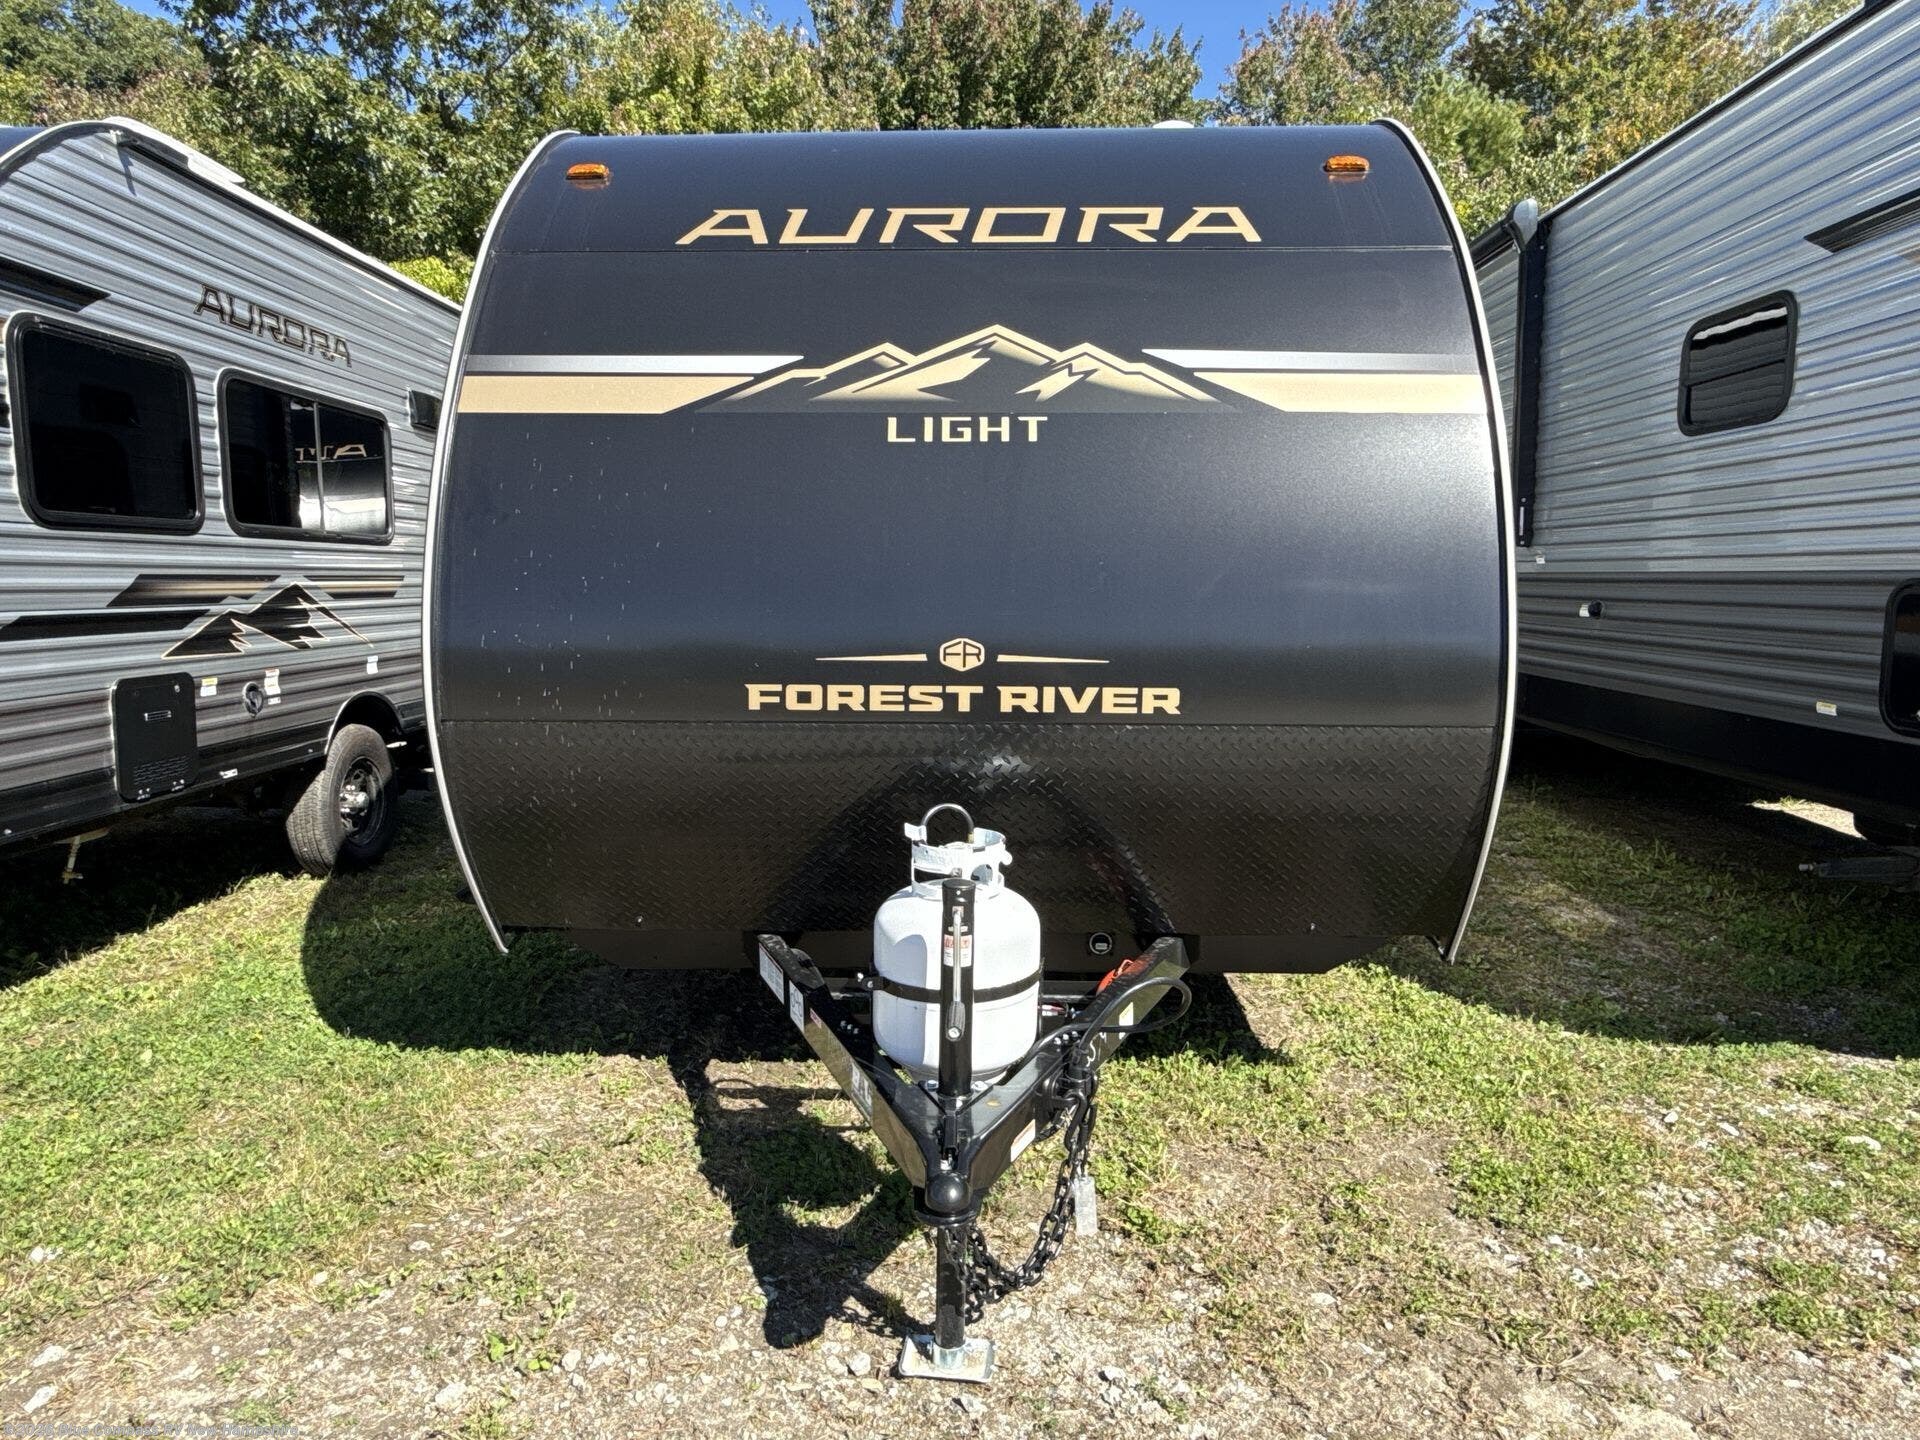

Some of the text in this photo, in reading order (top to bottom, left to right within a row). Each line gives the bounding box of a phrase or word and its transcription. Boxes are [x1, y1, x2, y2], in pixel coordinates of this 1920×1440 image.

[674, 206, 1262, 245] AURORA
[193, 284, 352, 368] AURORA
[886, 416, 1049, 443] LIGHT
[744, 683, 1182, 715] FOREST RIVER
